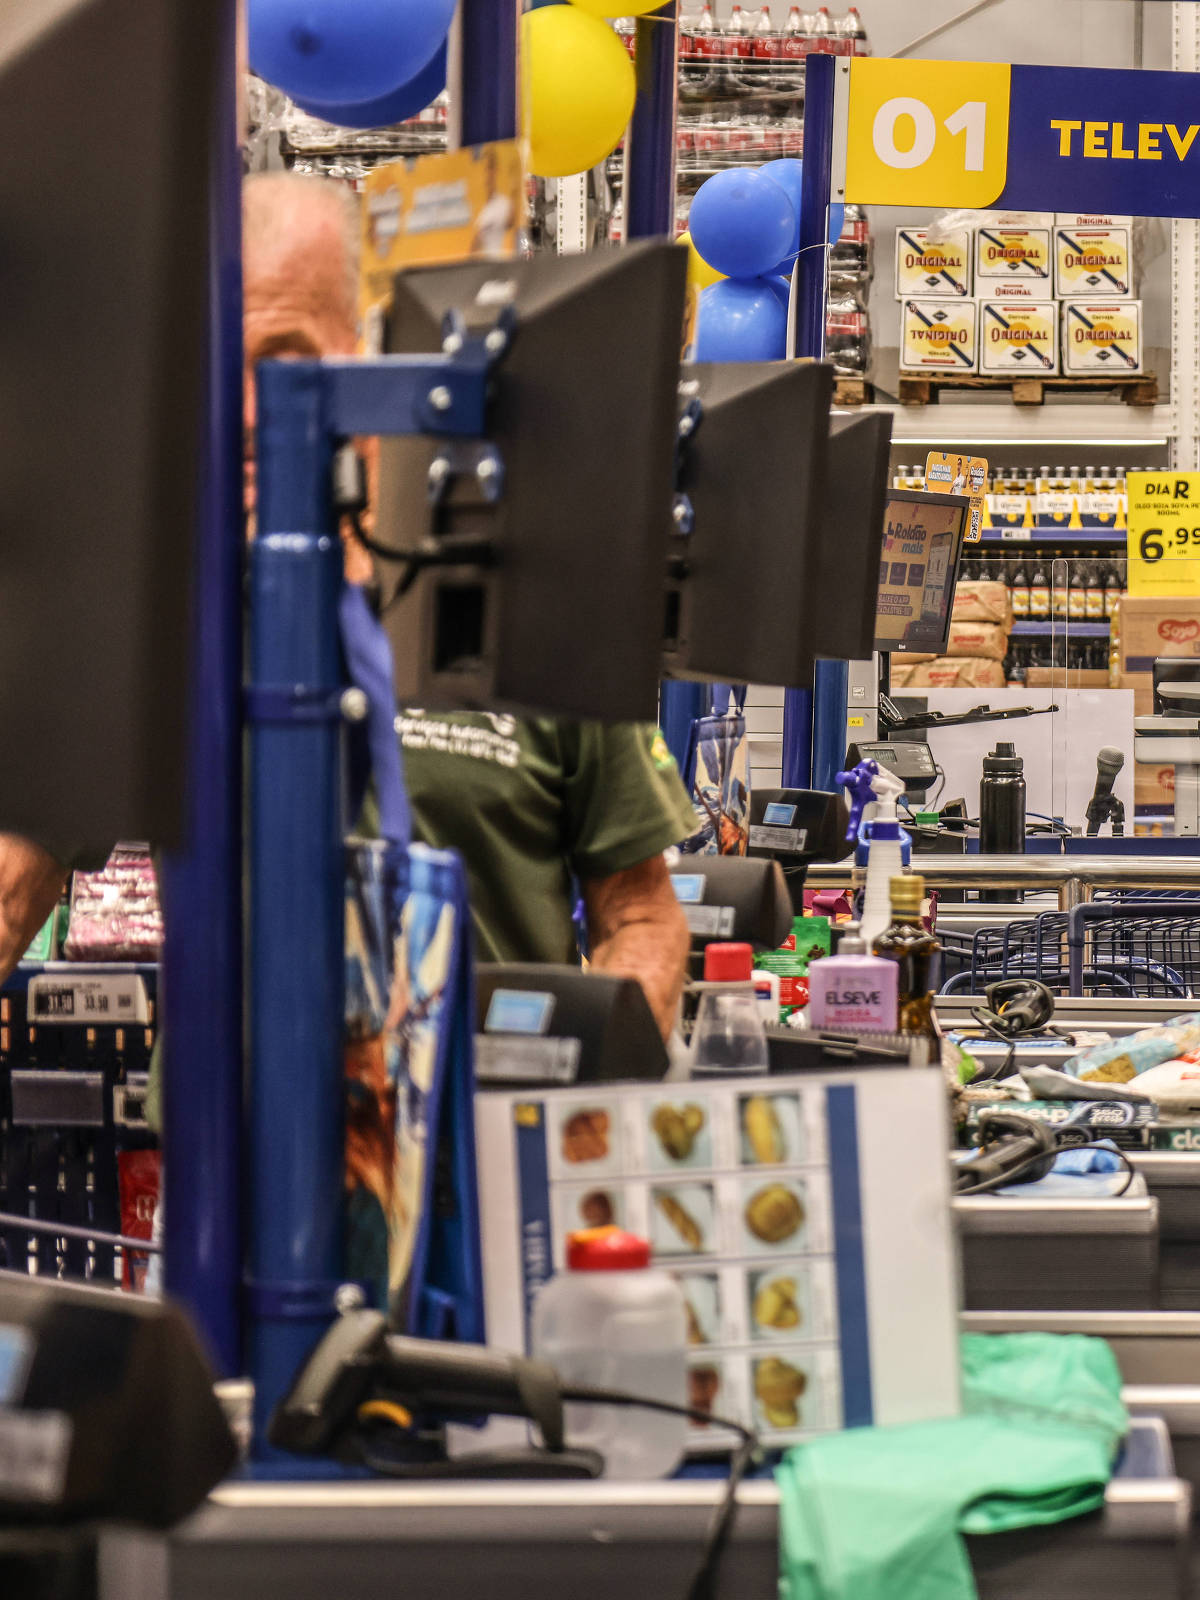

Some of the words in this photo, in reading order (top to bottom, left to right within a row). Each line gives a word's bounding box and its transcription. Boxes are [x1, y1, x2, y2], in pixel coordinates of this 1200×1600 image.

[872, 97, 987, 171] 01
[987, 247, 1040, 260] ORIGINAL
[905, 254, 962, 268] ORIGINAL
[1065, 254, 1122, 268] ORIGINAL
[991, 328, 1048, 342] ORIGINAL
[1075, 328, 1132, 342] ORIGINAL
[1145, 483, 1170, 495] DIA
[1174, 480, 1189, 499] R
[825, 991, 880, 1005] ELSEVE
